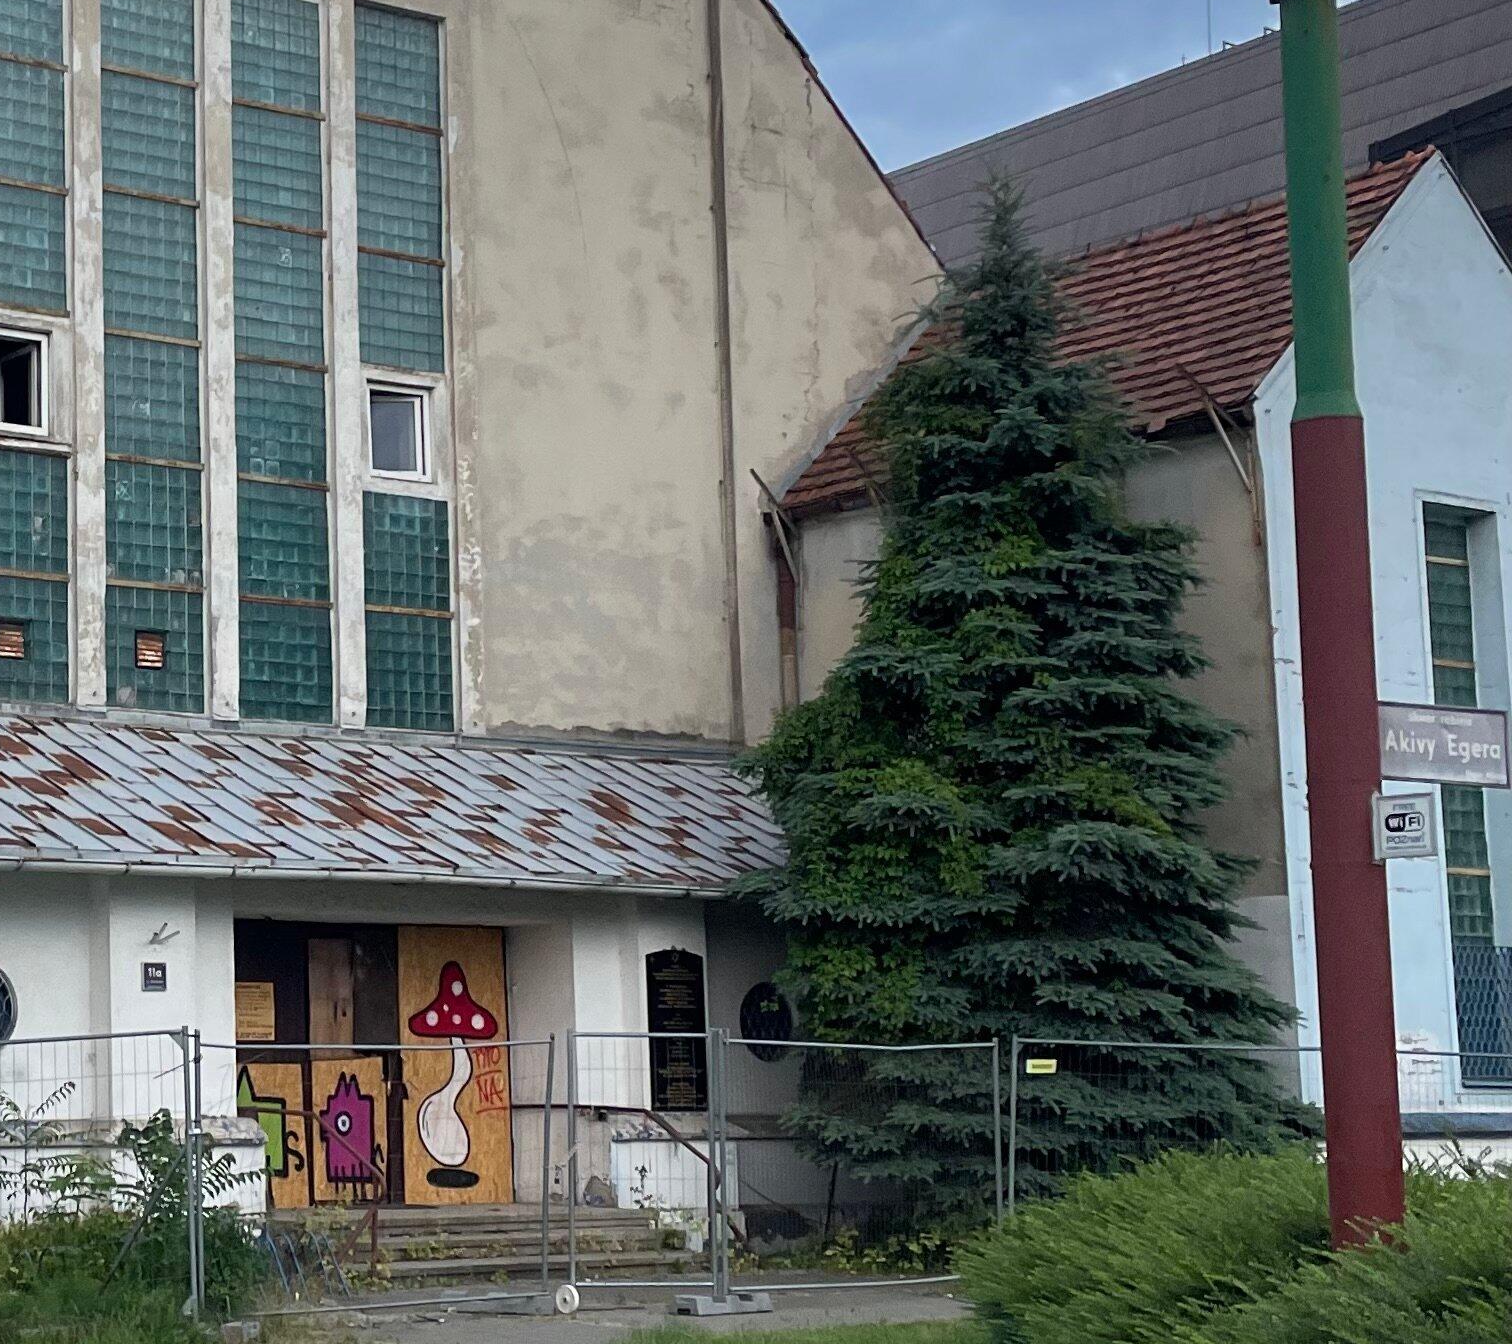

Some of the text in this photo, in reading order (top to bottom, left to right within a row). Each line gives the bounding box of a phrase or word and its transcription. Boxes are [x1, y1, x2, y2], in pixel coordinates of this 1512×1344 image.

[1386, 728, 1502, 763] Akivy Egera
[148, 967, 163, 977] 11a
